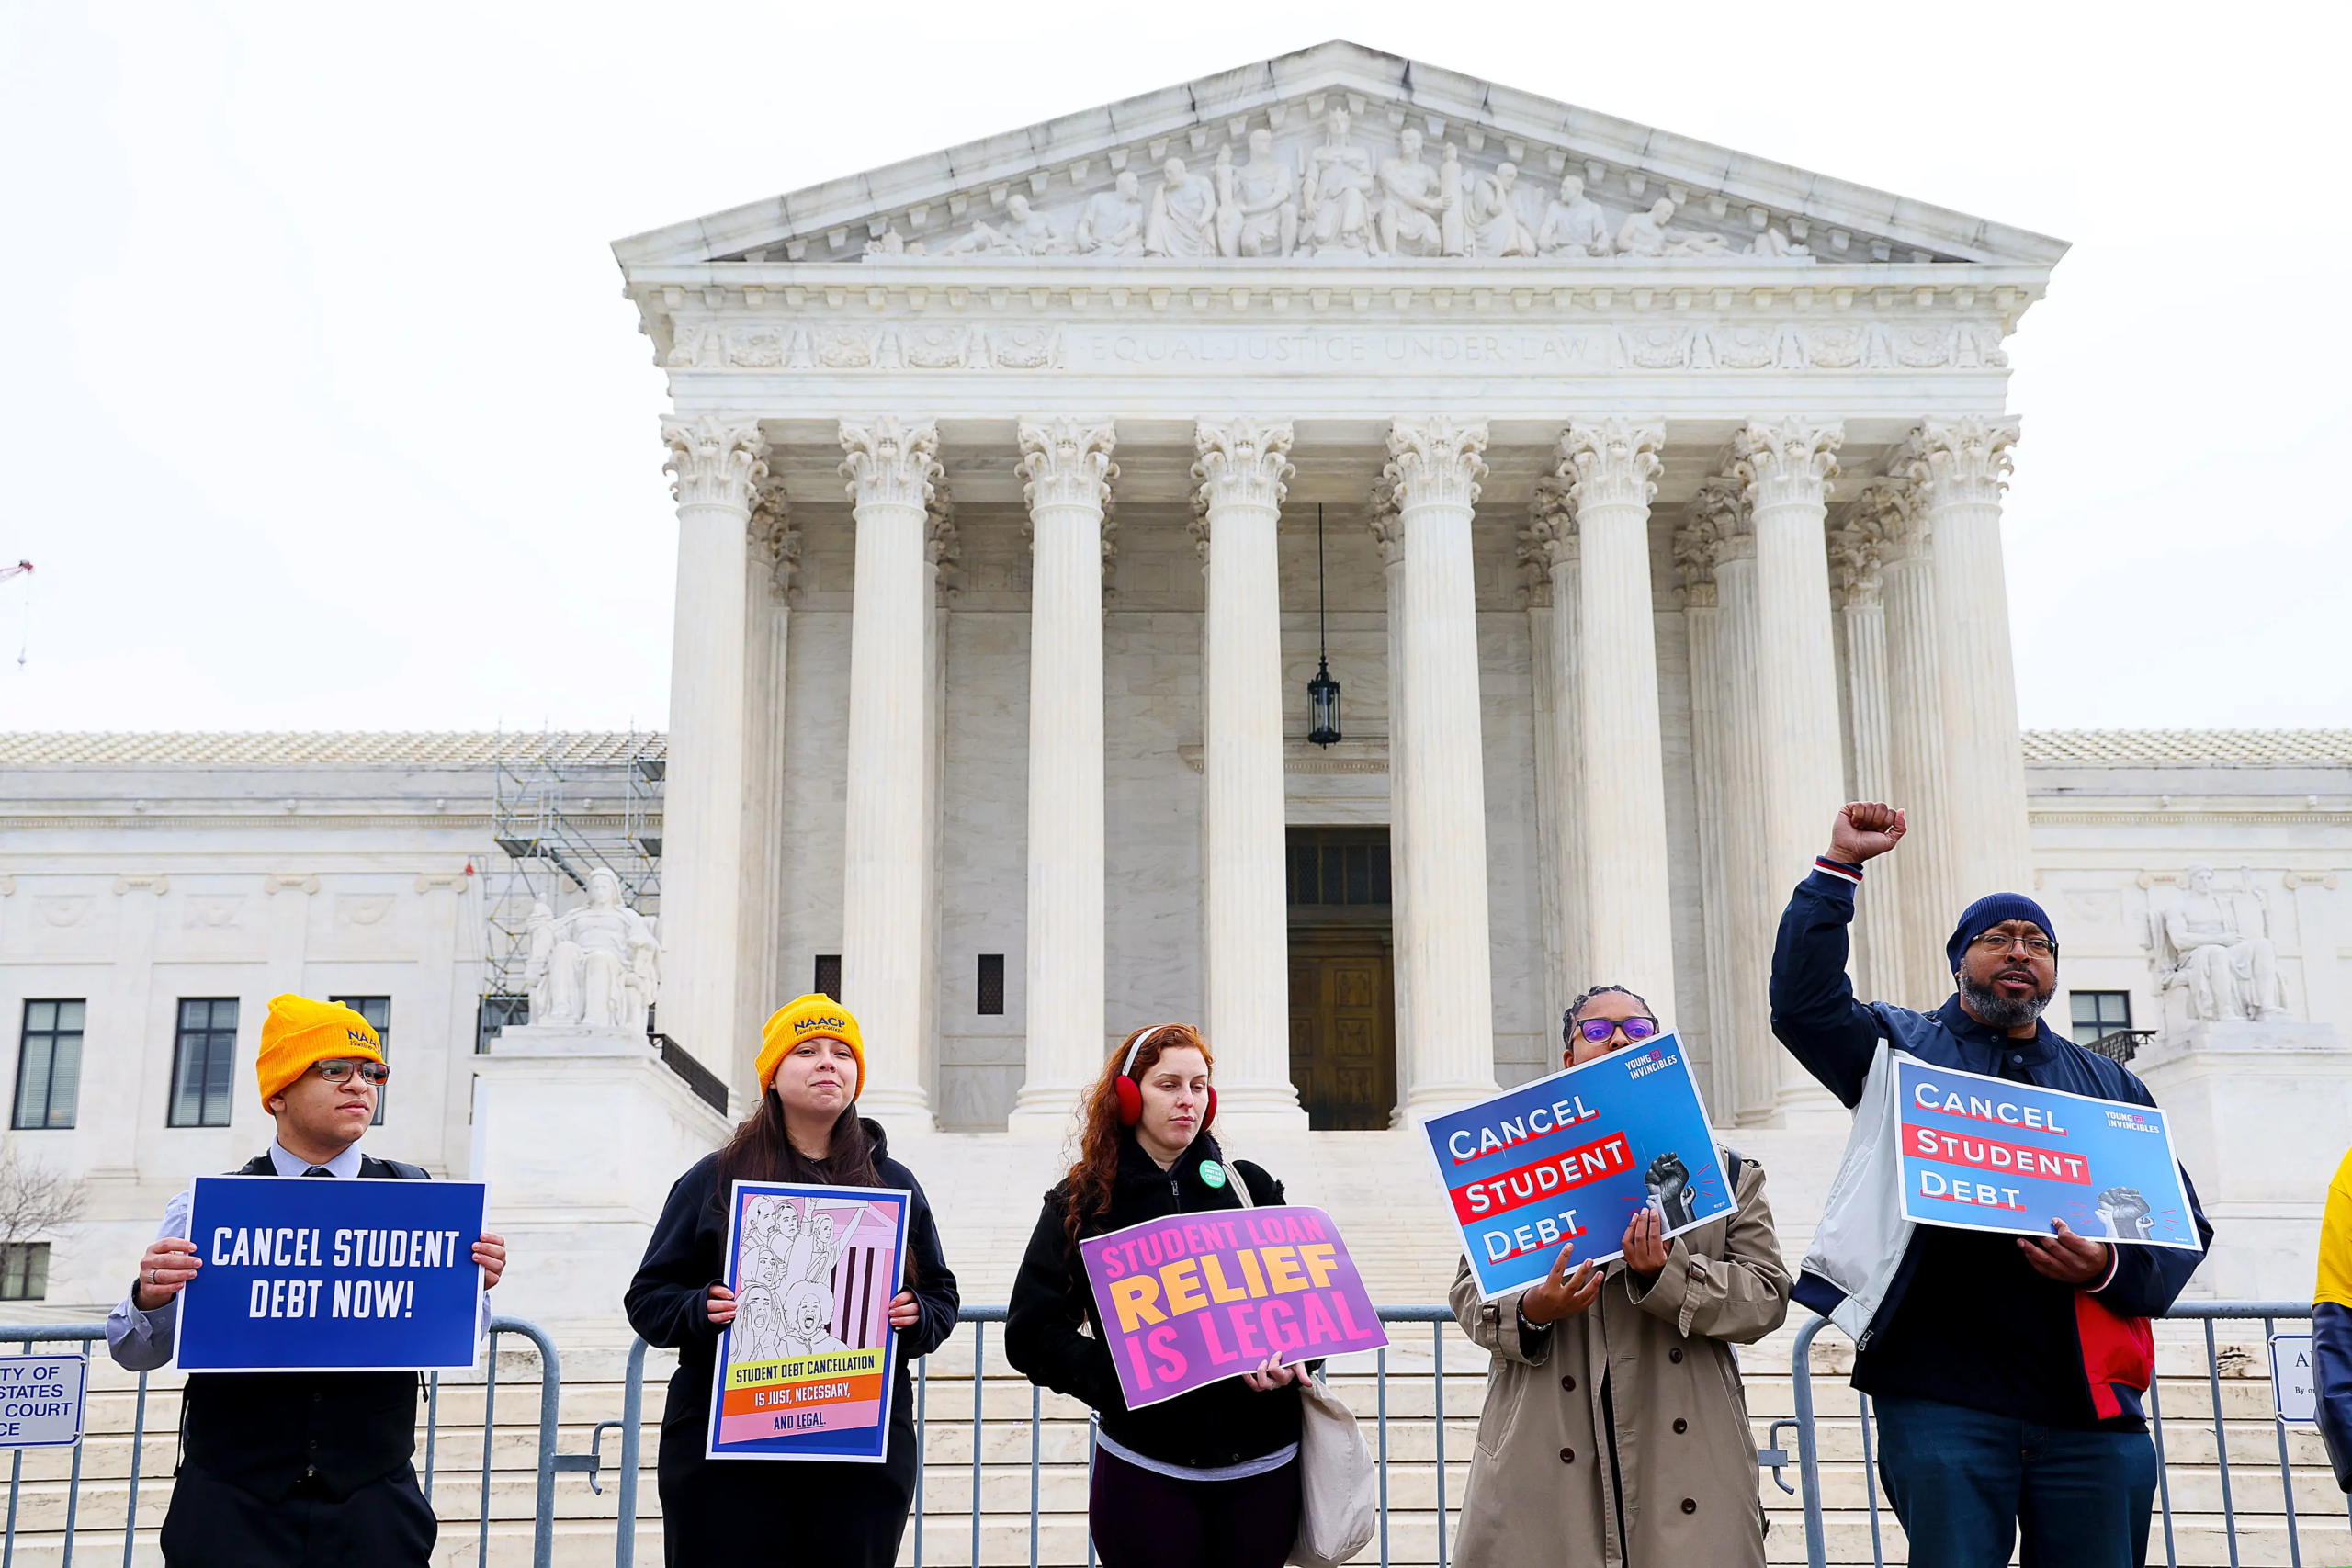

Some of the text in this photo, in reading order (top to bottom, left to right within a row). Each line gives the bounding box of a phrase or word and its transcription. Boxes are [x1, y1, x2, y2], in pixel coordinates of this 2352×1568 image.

[1091, 336, 1589, 363] EQUAL JUSTICE UNDER LAW
[794, 1017, 845, 1032] NAACP
[346, 1029, 381, 1054] NAA
[1624, 1054, 1652, 1071] YOUNG
[1629, 1055, 1678, 1080] INVINCIBLES
[1914, 1082, 2064, 1134] CANCEL
[2104, 1111, 2132, 1122] YOUNG
[1448, 1095, 1597, 1160] CANCEL
[2107, 1119, 2160, 1134] INVINCIBLES
[1917, 1128, 2084, 1179] STUDENT
[1465, 1139, 1623, 1213] STUDENT
[1920, 1169, 2020, 1209] DEBT
[211, 1227, 460, 1268] CANCEL STUDENT
[1101, 1215, 1326, 1278] STUDENT LOAN
[1482, 1209, 1579, 1262] DEBT
[249, 1280, 414, 1319] DEBT NOW!
[1109, 1243, 1339, 1334] RELIEF
[1125, 1291, 1373, 1392] IS LEGAL
[33, 1366, 60, 1381] OF
[736, 1355, 875, 1383] STUDENT DEBT CANCELLATION
[754, 1382, 851, 1406] IS JUST, NECESSARY,
[2295, 1386, 2304, 1395] By
[5, 1403, 73, 1417] COURT
[774, 1412, 827, 1430] AND LEGAL.
